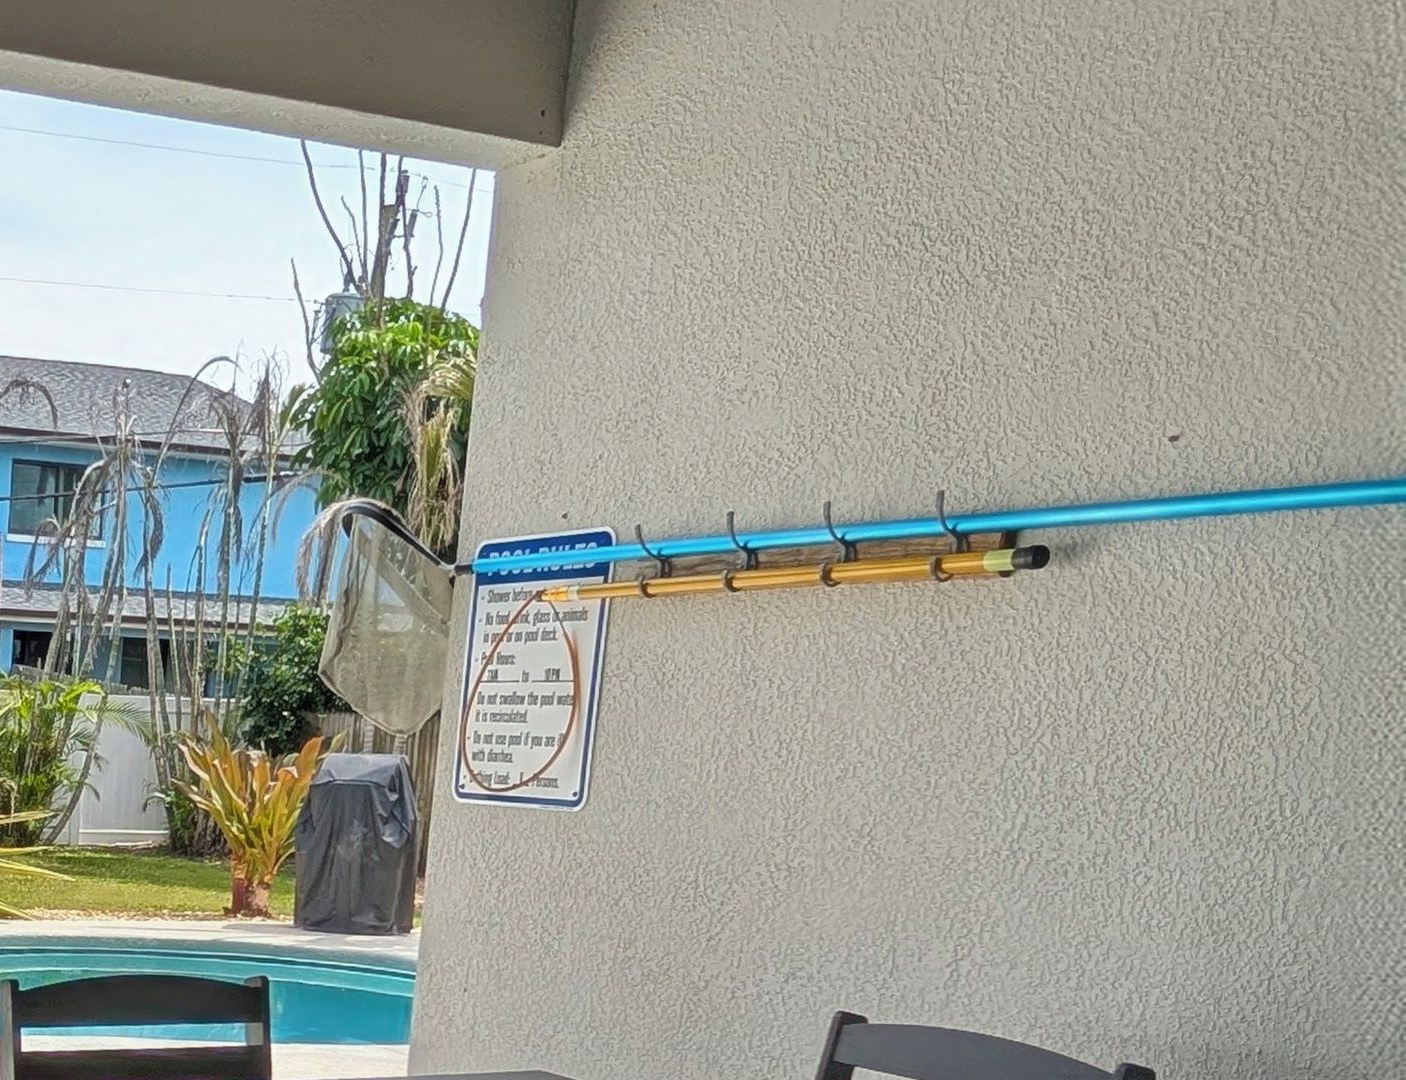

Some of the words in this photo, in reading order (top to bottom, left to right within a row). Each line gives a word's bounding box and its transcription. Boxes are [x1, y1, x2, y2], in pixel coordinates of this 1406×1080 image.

[487, 589, 511, 604] Shower
[485, 611, 494, 626] No
[532, 609, 551, 627] glass
[562, 607, 588, 622] animals
[491, 631, 505, 645] po
[514, 631, 523, 642] on
[524, 628, 539, 644] pool
[481, 651, 494, 665] Pol
[495, 652, 516, 666] Hours:
[521, 670, 530, 683] to
[477, 691, 485, 705] Do
[486, 692, 497, 705] not
[499, 691, 526, 706] swallow
[527, 691, 539, 706] the
[540, 691, 555, 708] pool
[556, 692, 575, 706] wate
[475, 709, 481, 722] it
[482, 709, 488, 722] is
[473, 730, 481, 744] Do
[482, 732, 494, 745] not
[495, 734, 506, 745] use
[507, 731, 522, 748] pool
[523, 731, 530, 746] if
[530, 735, 543, 750] you
[544, 736, 555, 748] are
[472, 749, 485, 762] with
[470, 770, 492, 787] thing
[531, 776, 559, 789] ersons.
